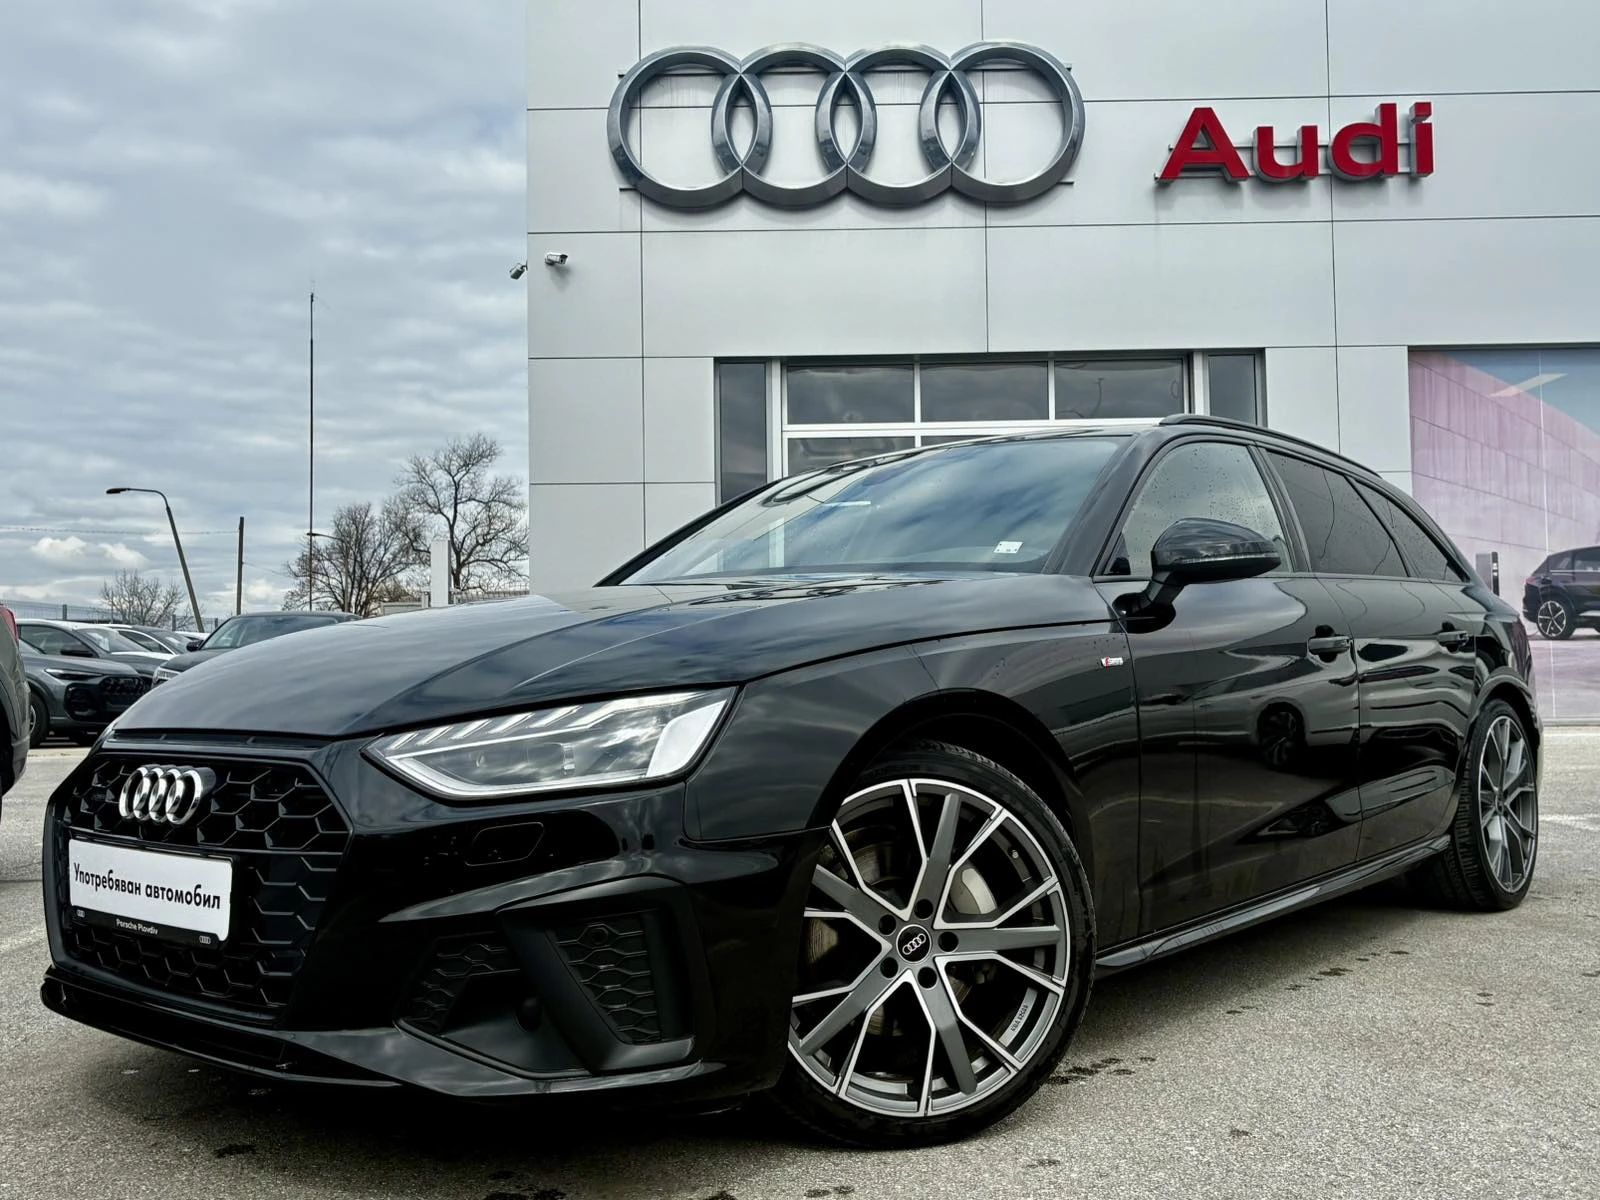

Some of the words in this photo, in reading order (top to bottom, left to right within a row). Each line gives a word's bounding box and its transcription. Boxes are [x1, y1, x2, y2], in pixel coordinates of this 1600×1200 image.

[1157, 102, 1434, 181] Audi
[73, 862, 142, 896] Употребяван
[145, 884, 221, 909] автомобил
[115, 918, 138, 931] Porsche
